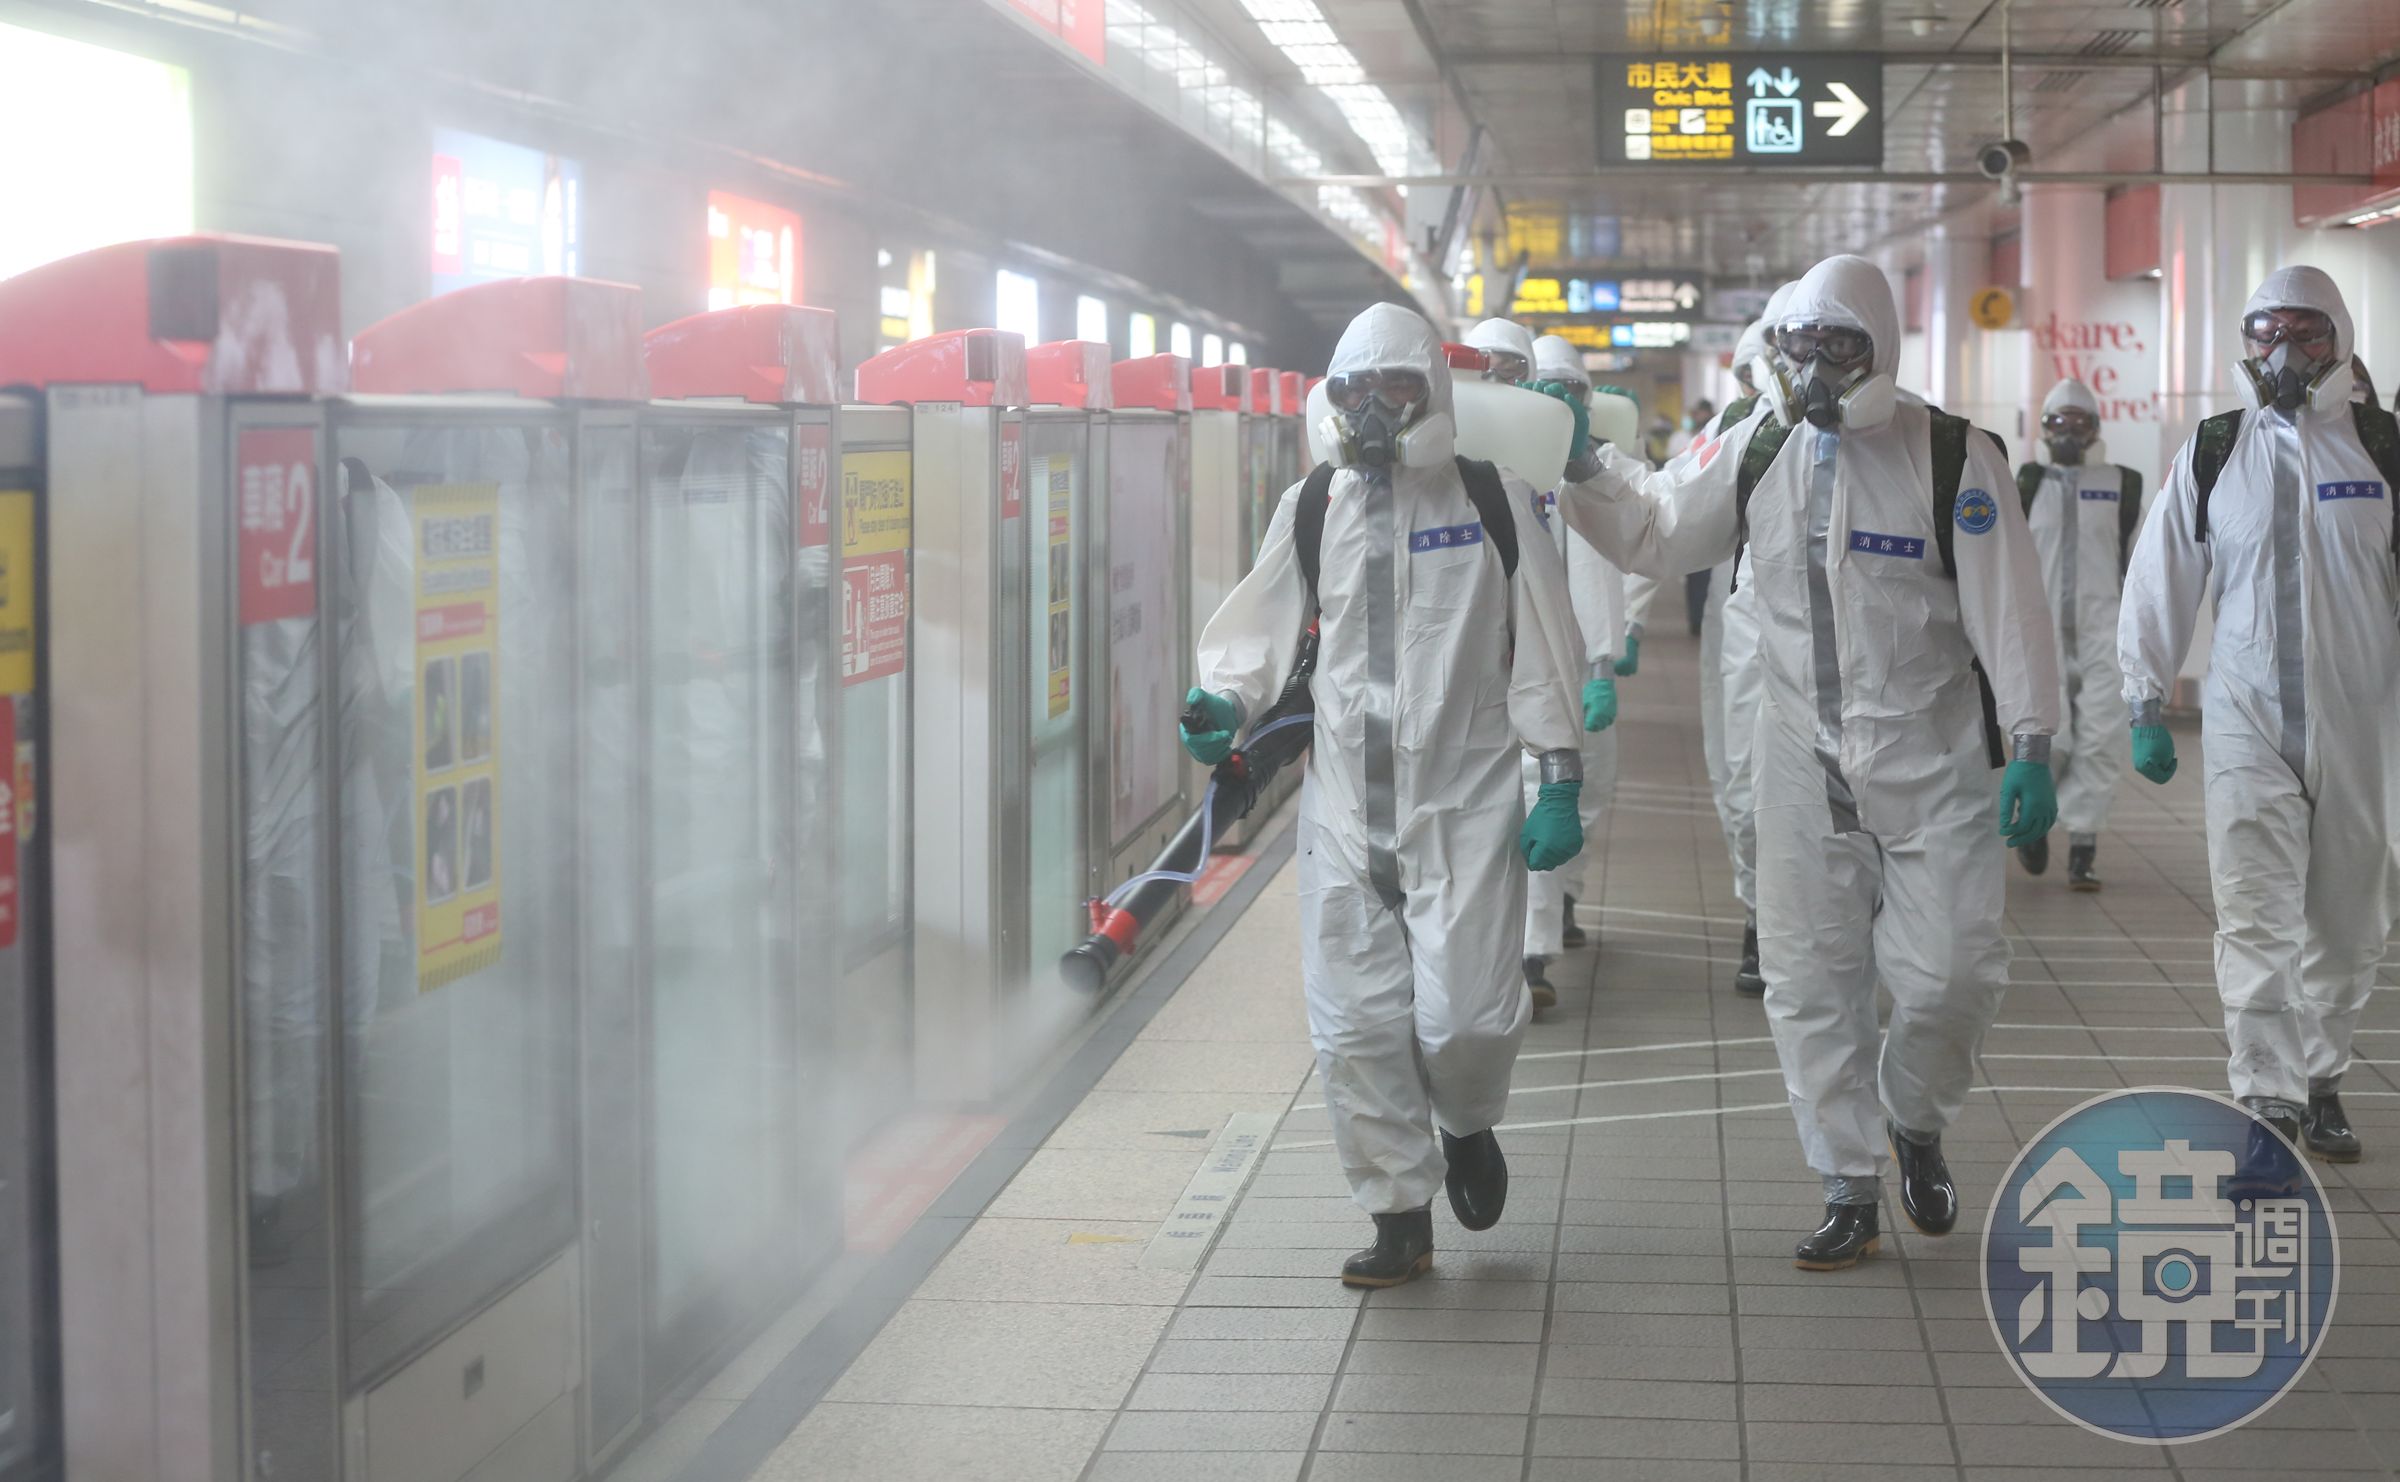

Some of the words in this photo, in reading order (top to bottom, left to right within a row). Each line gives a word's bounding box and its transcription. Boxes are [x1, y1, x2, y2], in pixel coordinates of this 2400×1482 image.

[1626, 62, 1733, 89] 市民大道
[1653, 91, 1693, 106] Civic
[1013, 440, 1019, 500] 2
[818, 448, 827, 524] 2
[2326, 484, 2376, 497] 消除士
[286, 461, 311, 584] 2
[1418, 530, 1473, 548] 消除士
[1859, 536, 1915, 553] 消除士
